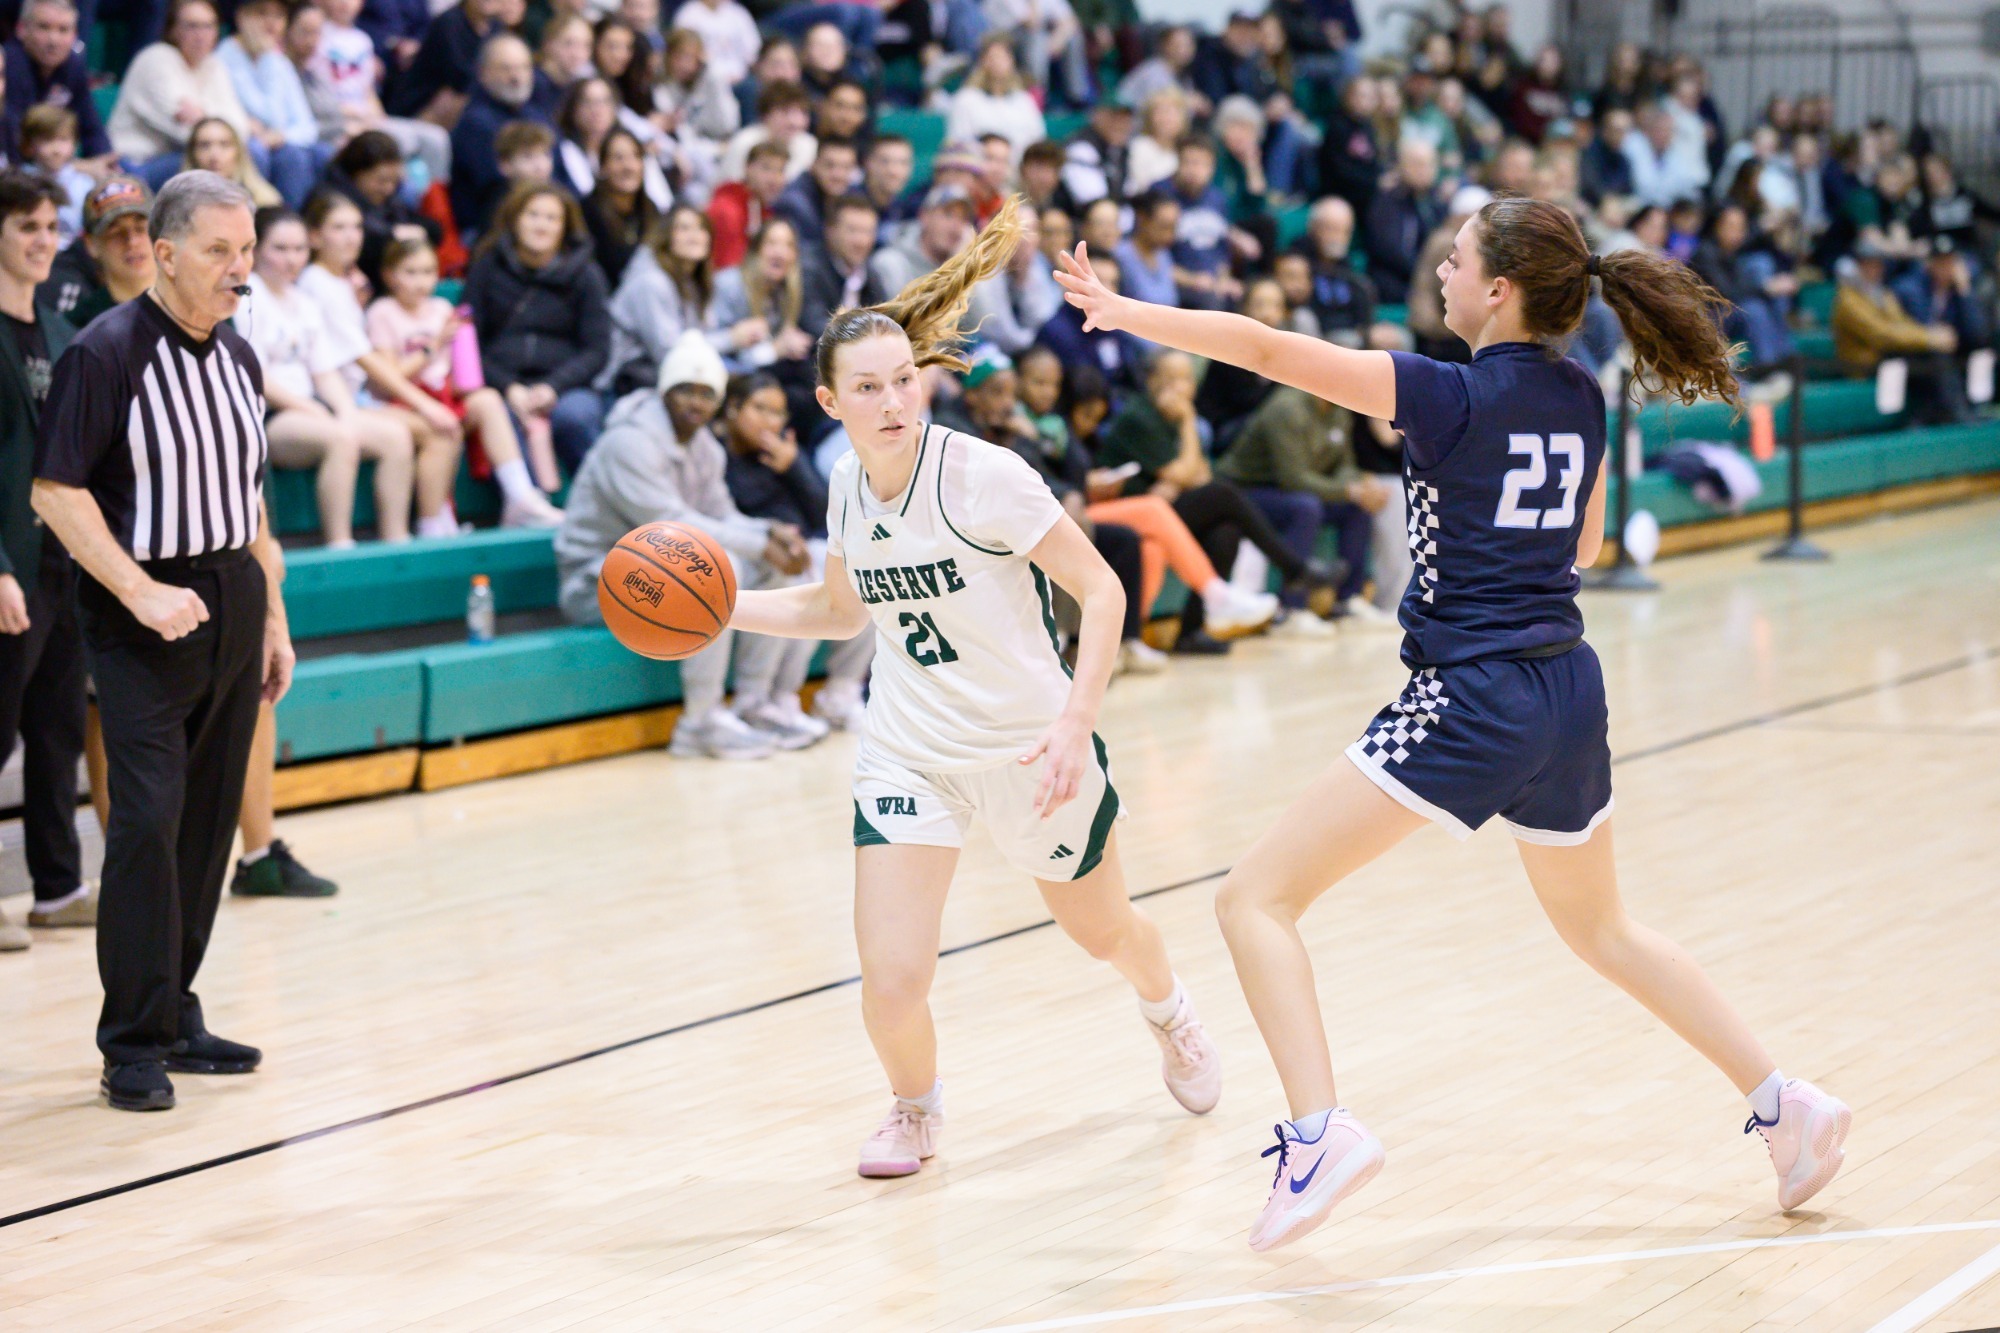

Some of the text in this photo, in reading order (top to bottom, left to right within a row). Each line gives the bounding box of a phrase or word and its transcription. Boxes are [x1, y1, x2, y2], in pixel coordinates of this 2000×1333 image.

[1494, 433, 1585, 529] 23
[635, 528, 713, 577] Rawlings
[626, 574, 661, 604] OHSAA
[898, 611, 959, 667] 21
[876, 796, 918, 816] WRA
